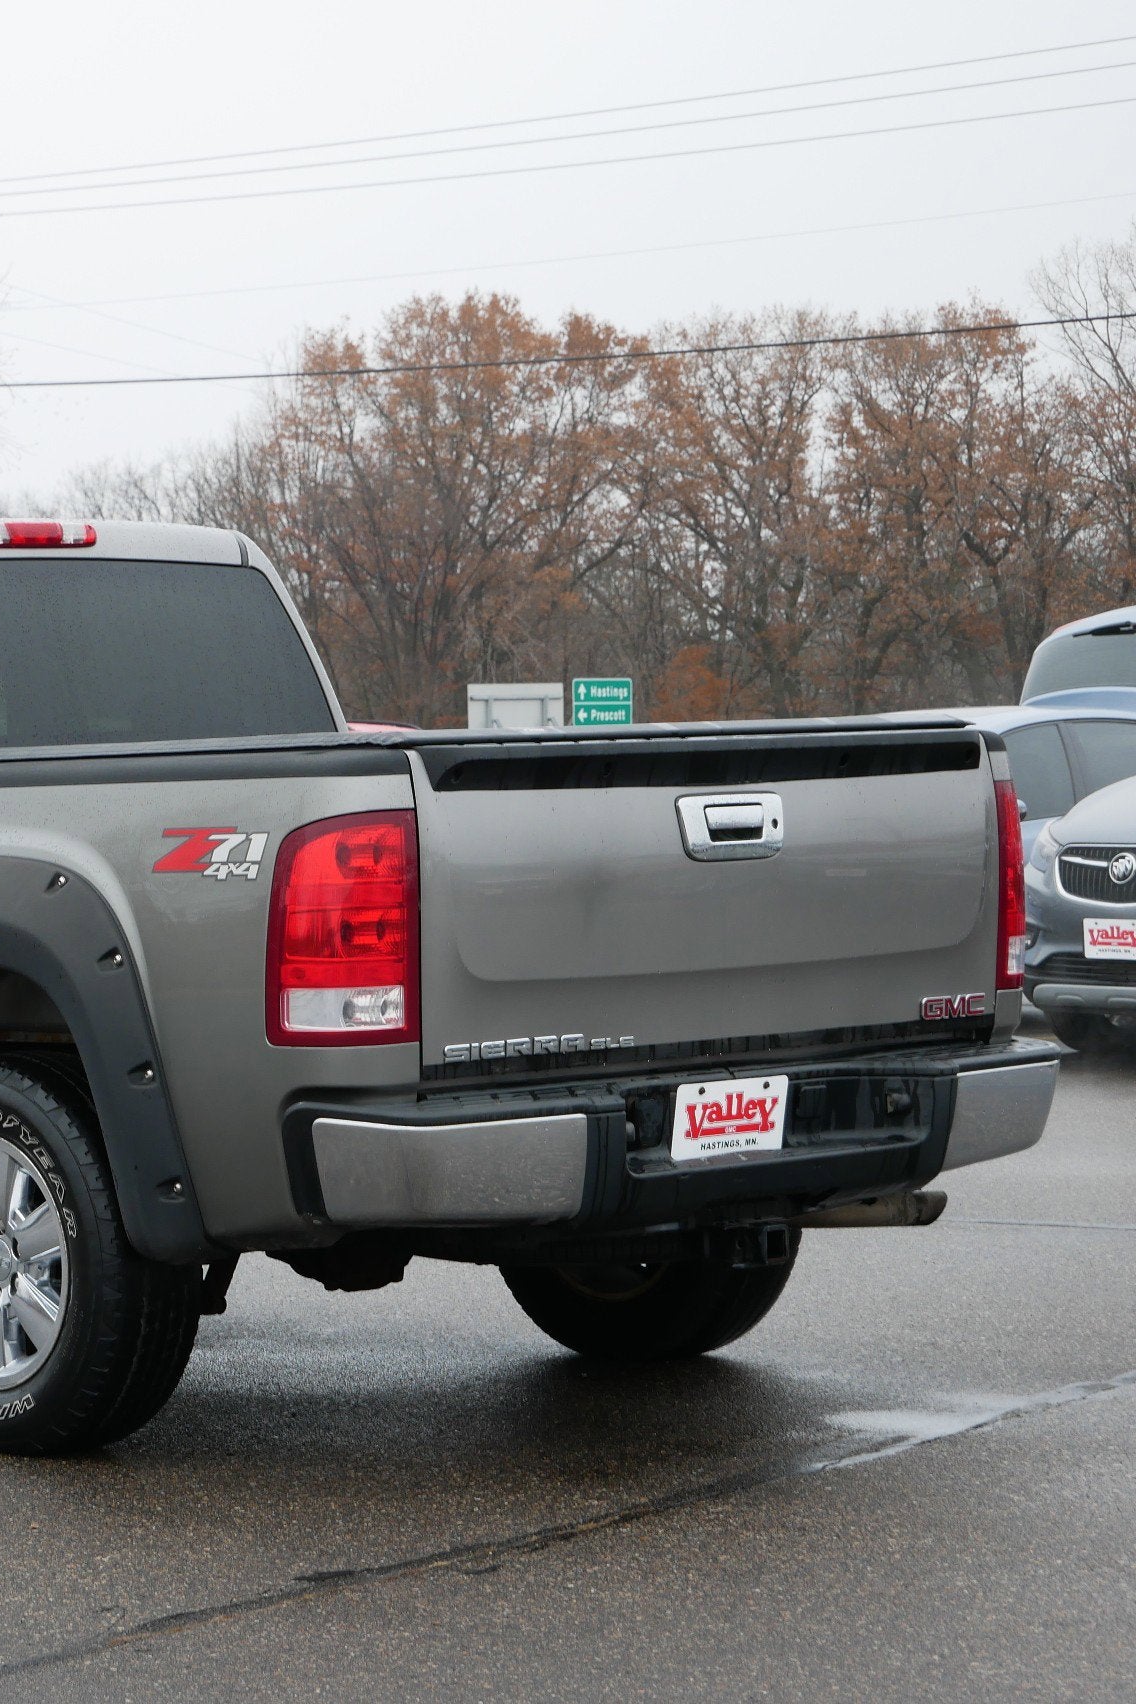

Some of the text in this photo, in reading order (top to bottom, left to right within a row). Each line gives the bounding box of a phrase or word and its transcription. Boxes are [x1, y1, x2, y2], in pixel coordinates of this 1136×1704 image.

[590, 686, 629, 700] Hastings
[590, 709, 626, 721] Prescott
[152, 826, 270, 873] Z71
[920, 992, 985, 1020] GMC
[443, 1033, 635, 1063] SIERRA SLE
[685, 1092, 780, 1140] Valley
[700, 1137, 759, 1151] HASTINGS, MN.
